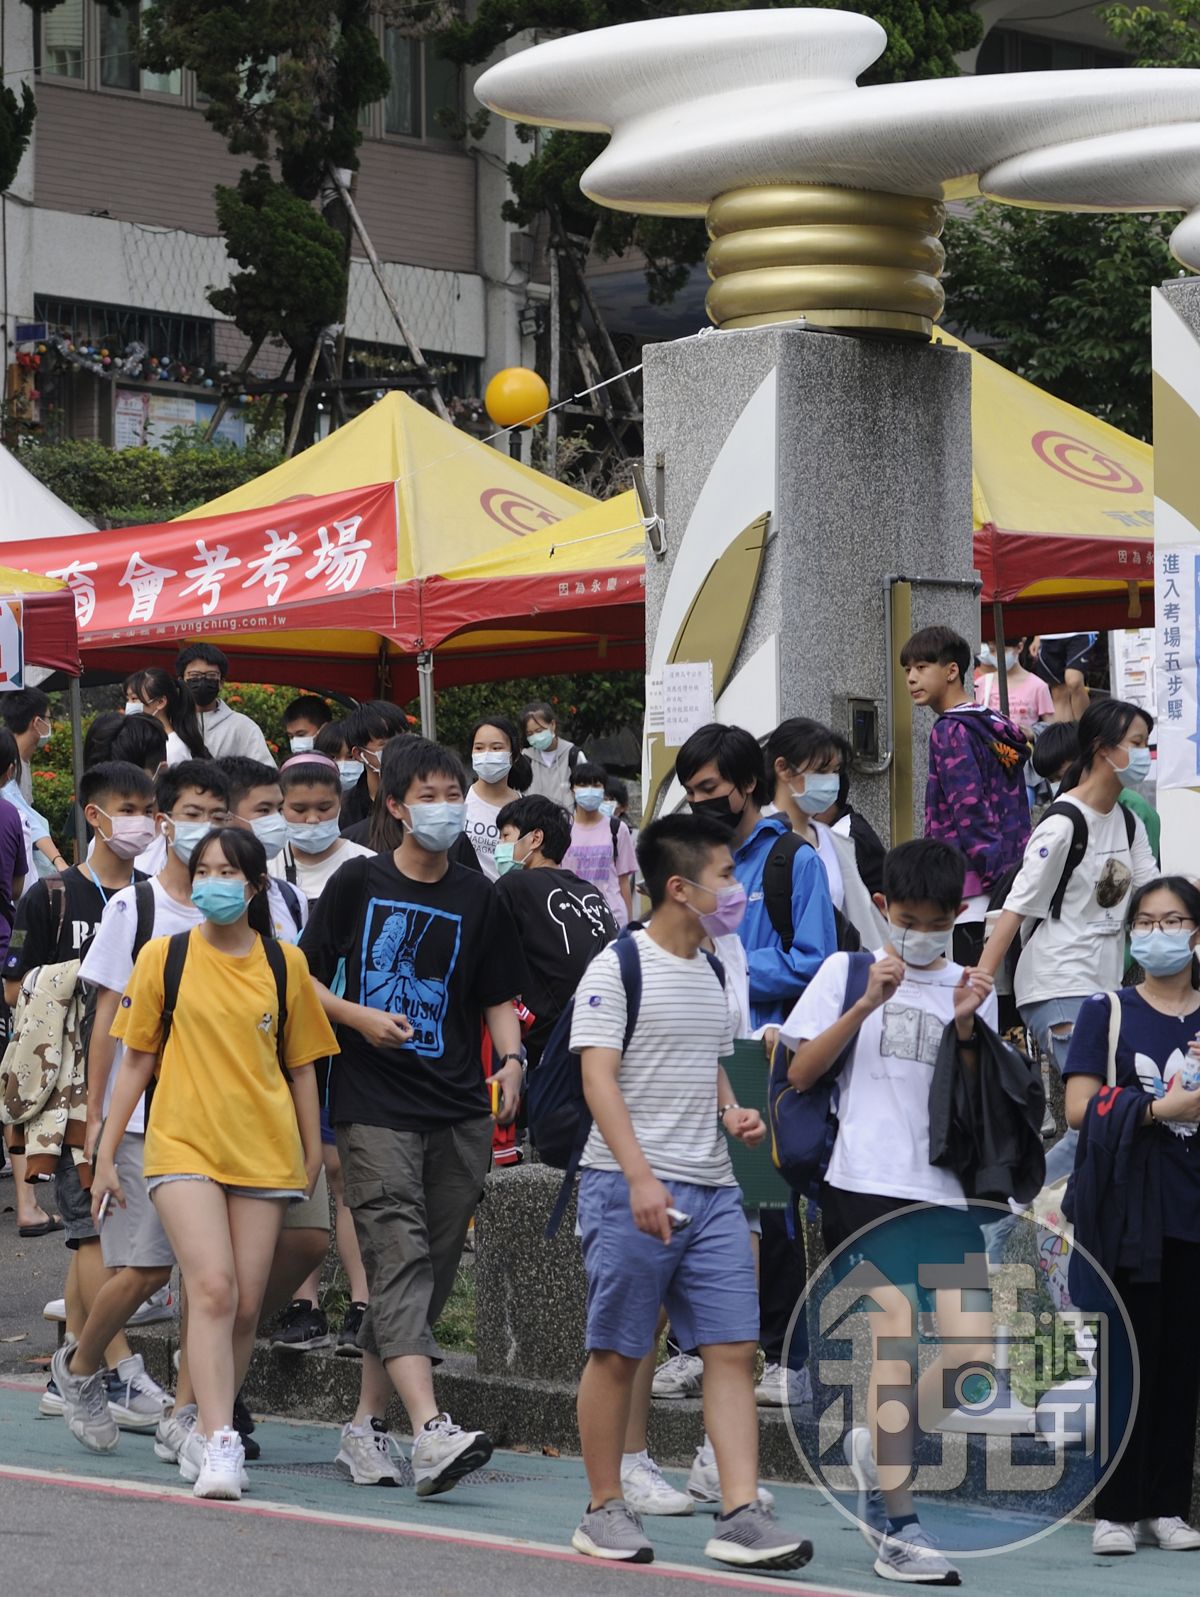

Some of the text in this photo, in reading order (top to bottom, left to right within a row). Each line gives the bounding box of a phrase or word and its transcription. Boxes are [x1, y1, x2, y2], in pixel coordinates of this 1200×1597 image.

[173, 615, 287, 633] yungching.com.tw
[1162, 553, 1183, 721] 進入考場五步驟
[465, 820, 499, 838] LOO
